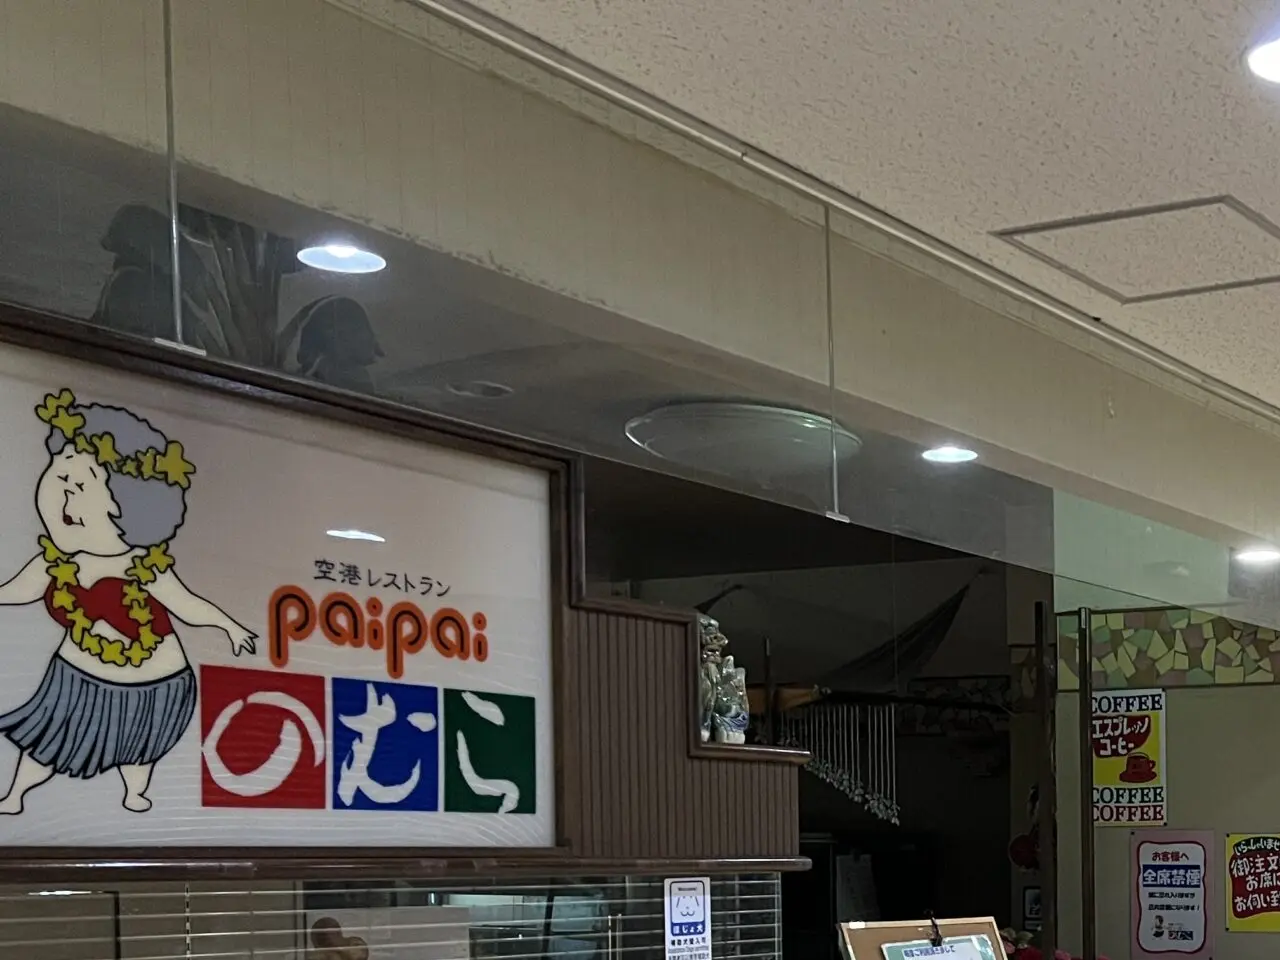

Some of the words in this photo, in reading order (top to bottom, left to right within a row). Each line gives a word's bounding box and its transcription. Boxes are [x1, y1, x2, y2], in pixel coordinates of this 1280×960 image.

[313, 558, 451, 597] 空港レストラン
[268, 584, 489, 679] paipai
[1092, 717, 1149, 739] エスプレッソ
[1100, 737, 1135, 756] コーヒー
[1143, 869, 1201, 886] 全席禁煙
